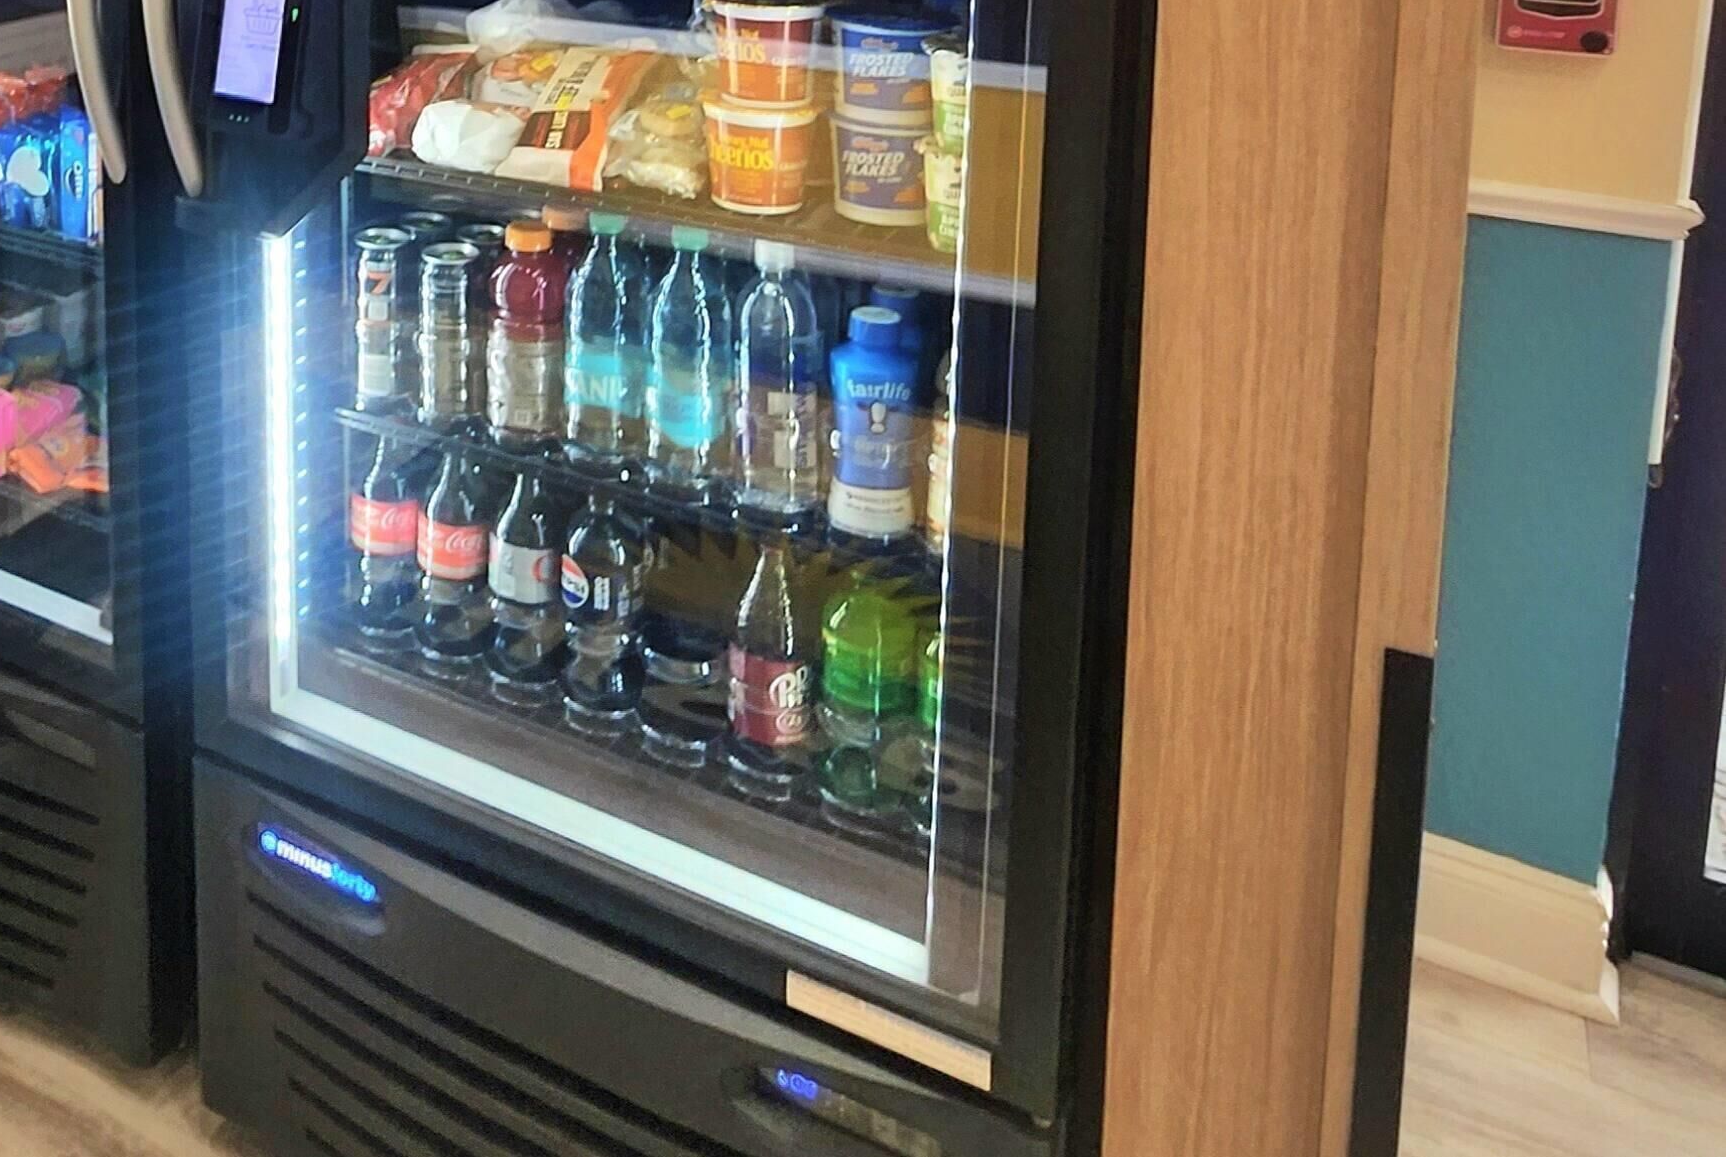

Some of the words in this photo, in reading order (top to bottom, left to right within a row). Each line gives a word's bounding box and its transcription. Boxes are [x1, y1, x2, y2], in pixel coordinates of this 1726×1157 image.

[849, 51, 915, 66] FROSTED
[851, 64, 907, 78] FLAKES
[842, 150, 905, 165] FROSTED
[845, 163, 898, 178] FLAKES
[846, 378, 913, 402] fairlife
